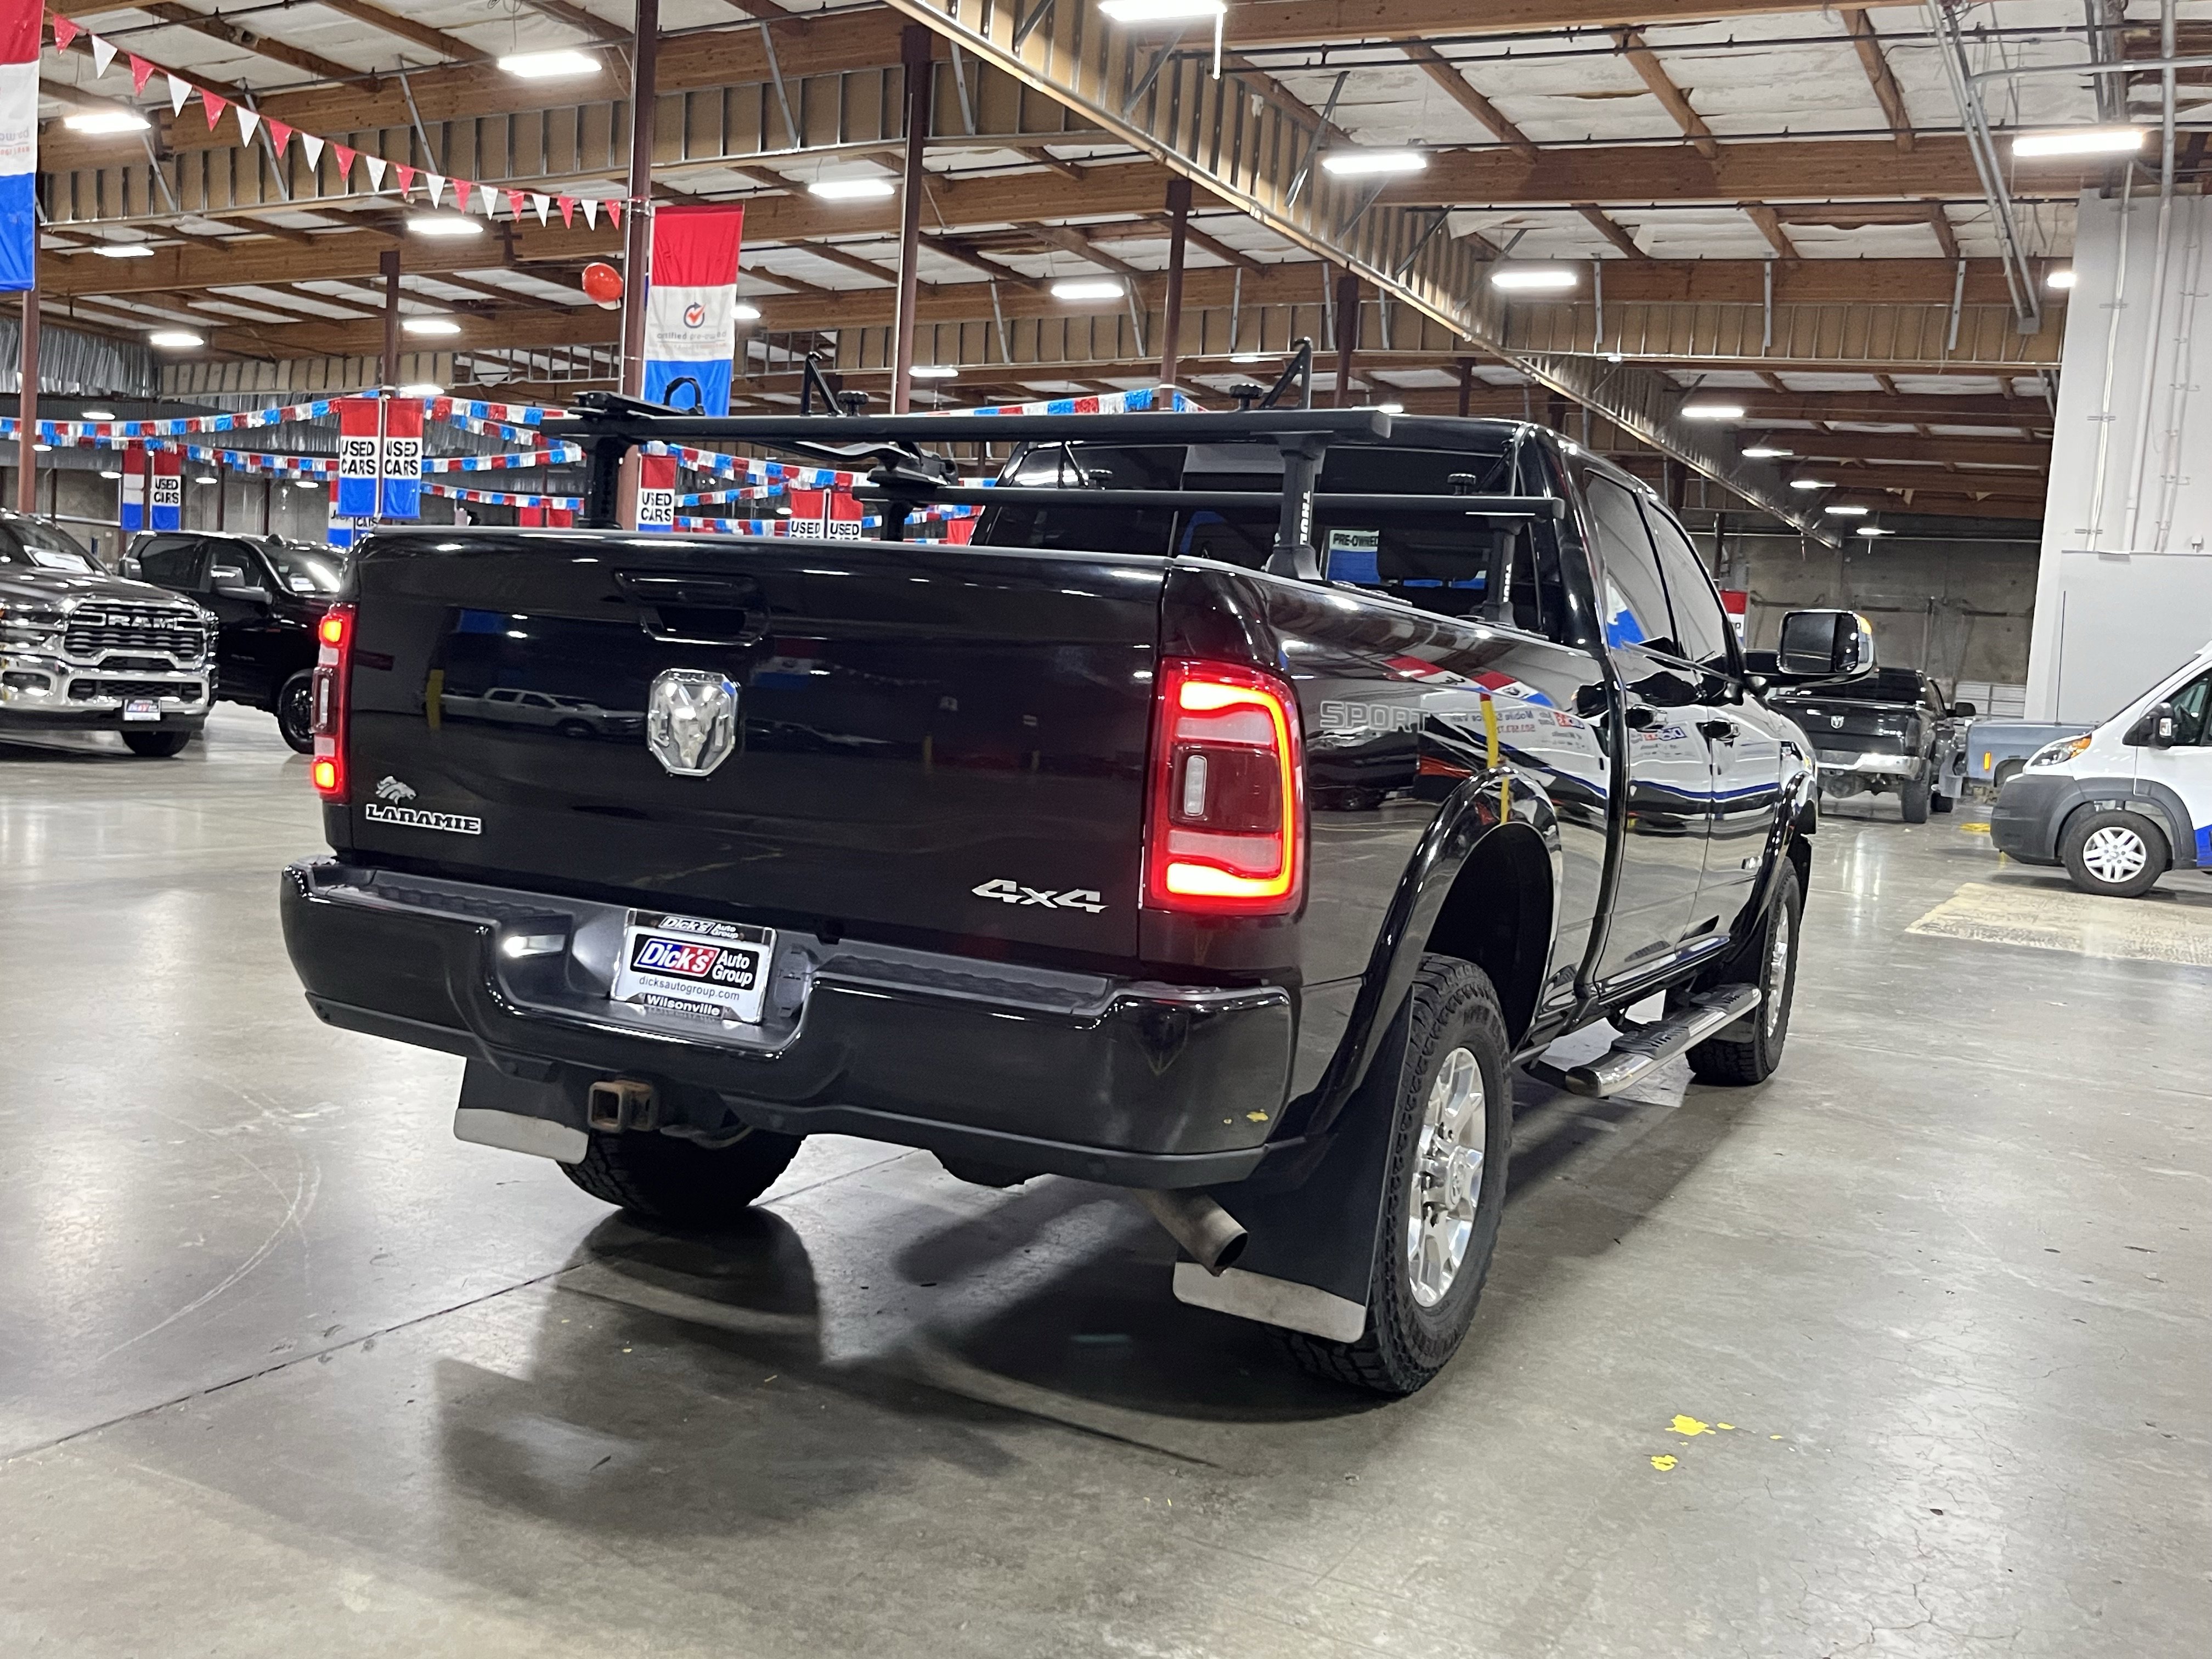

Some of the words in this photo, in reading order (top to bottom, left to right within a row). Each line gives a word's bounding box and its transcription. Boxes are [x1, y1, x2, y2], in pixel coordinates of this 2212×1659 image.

[341, 440, 375, 457] USED
[386, 441, 418, 457] USED
[341, 459, 376, 475] CARS
[385, 459, 418, 476] CARS
[155, 478, 179, 490] USED
[642, 491, 672, 506] USED
[641, 507, 672, 522] CARS
[1300, 490, 1311, 545] THUL
[791, 521, 821, 534] USED
[830, 523, 860, 535] USED
[108, 614, 176, 629] RAM
[1320, 700, 1431, 733] SPORT
[366, 803, 482, 834] LARAMIE
[971, 878, 1109, 913] 4x4
[712, 930, 739, 940] Group
[714, 923, 736, 933] Auto
[641, 942, 712, 973] Dick's
[716, 950, 750, 969] Auto
[712, 964, 753, 988] Group
[639, 975, 740, 1001] dicksautogroup.com
[647, 994, 721, 1017] Wilsonville
